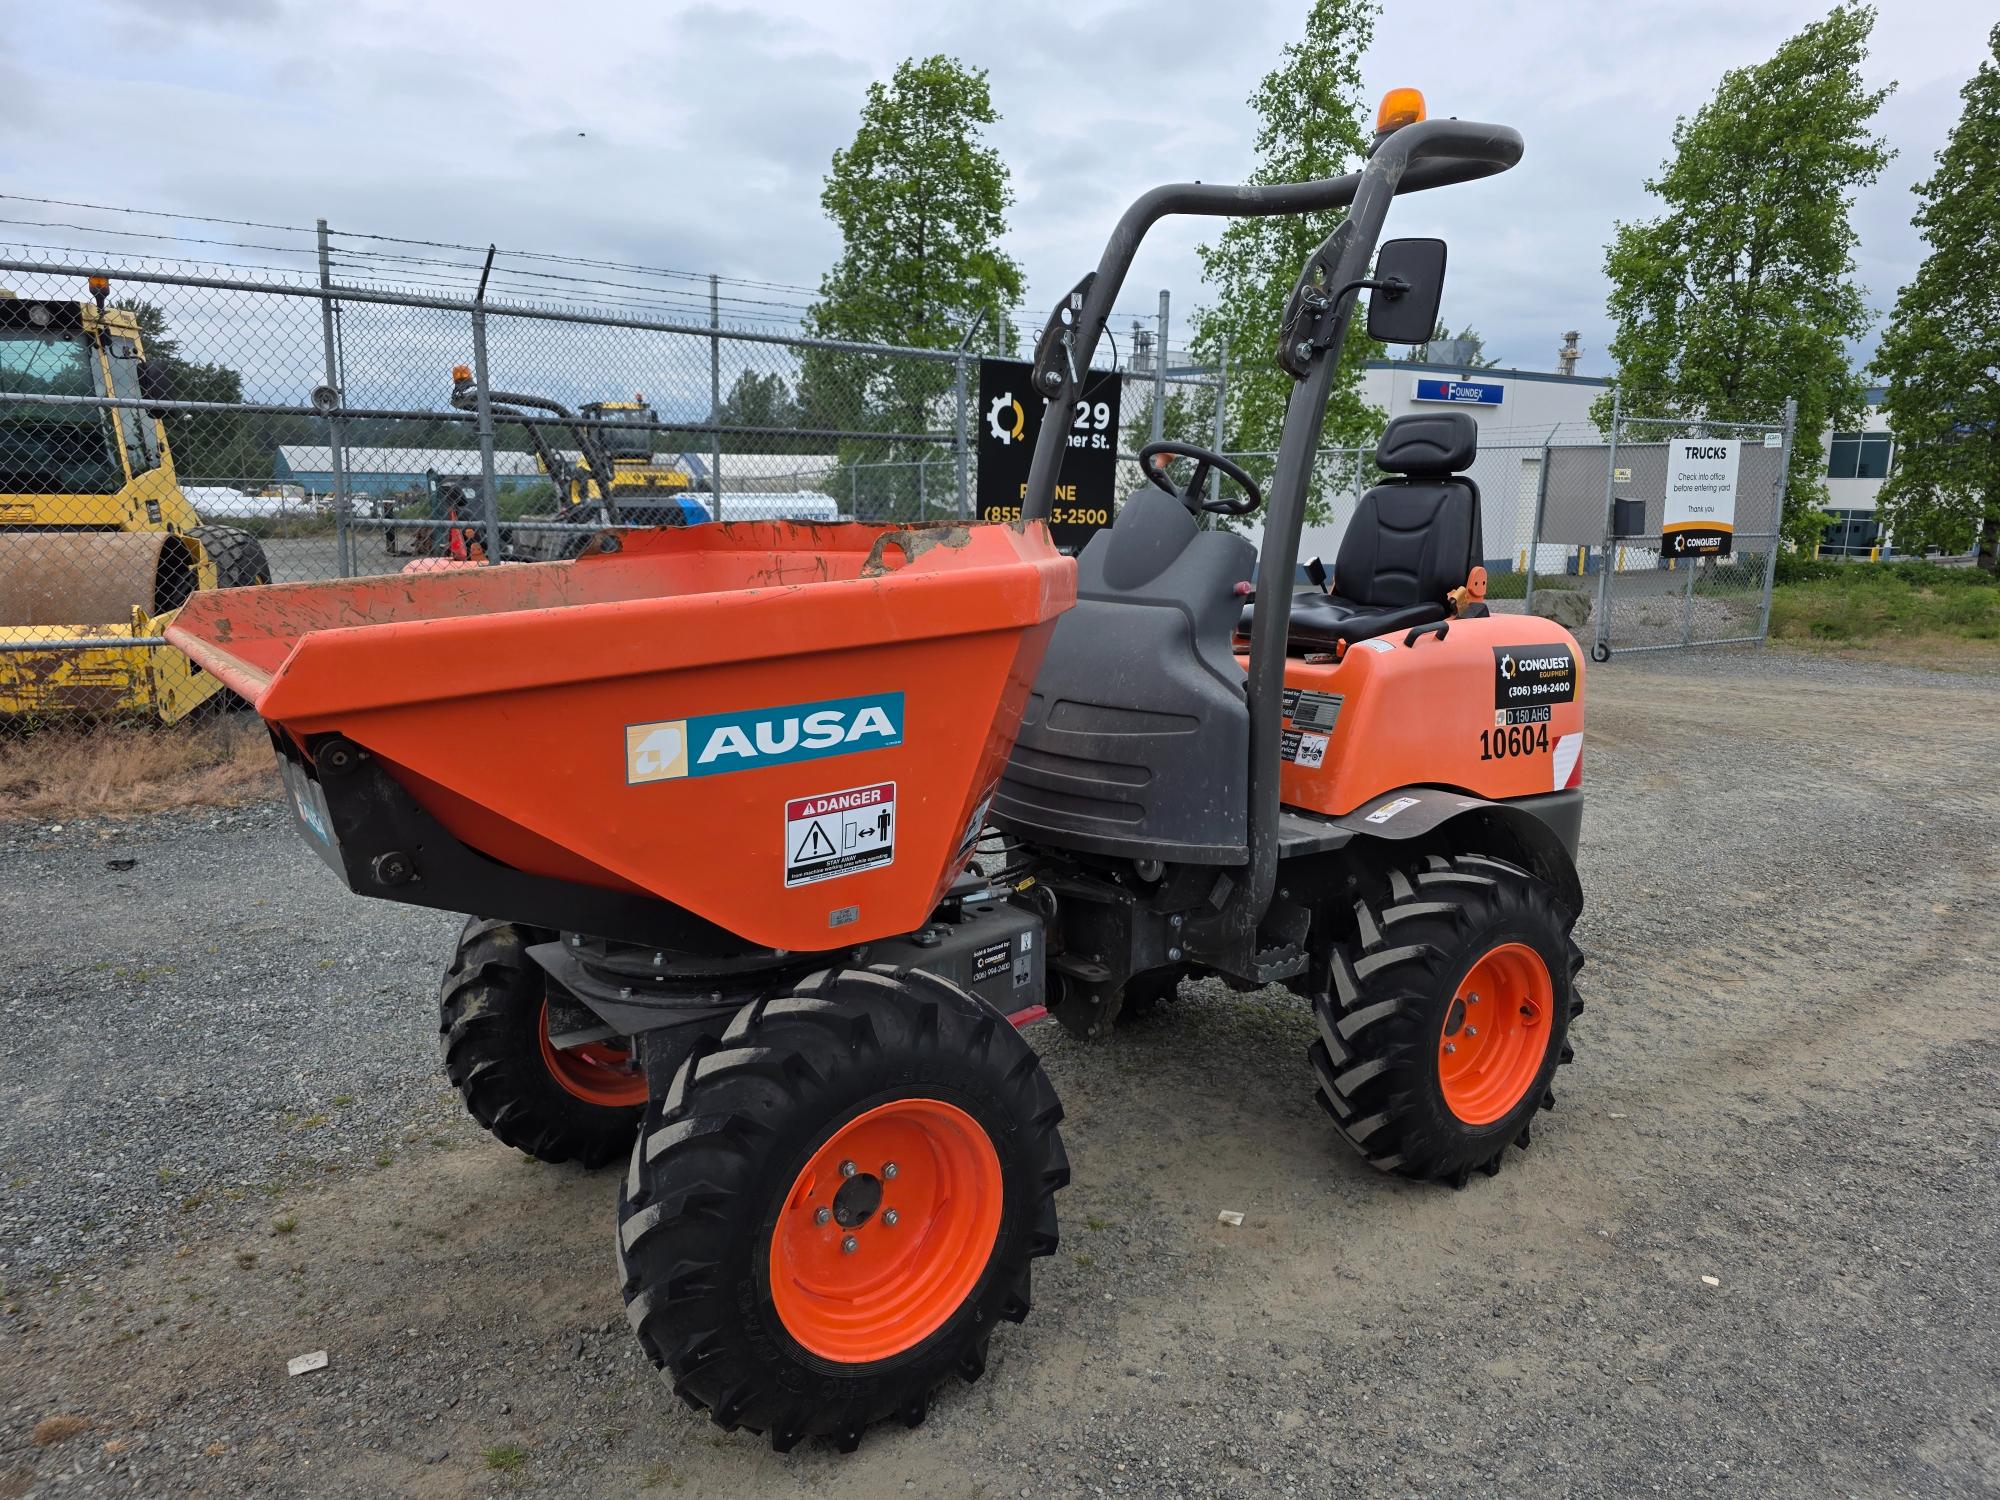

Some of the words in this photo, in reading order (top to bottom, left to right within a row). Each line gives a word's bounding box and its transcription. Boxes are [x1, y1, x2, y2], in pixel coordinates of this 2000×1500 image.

[1091, 433, 1110, 449] St.
[1685, 446, 1727, 460] TRUCKS
[1678, 472, 1697, 481] Check
[1698, 472, 1709, 481] into
[1710, 472, 1726, 481] office
[1020, 483, 1077, 500] PNE
[1673, 484, 1693, 492] before
[1694, 484, 1718, 494] entering
[1718, 484, 1731, 494] yard
[984, 506, 1021, 522] (855
[1048, 508, 1108, 525] 3-2500
[1688, 505, 1703, 513] Thank
[1704, 505, 1715, 514] you
[1686, 538, 1721, 547] CONQUEST
[1519, 657, 1569, 672] CONQUEST
[1540, 670, 1569, 678] EQUIPMENT
[1508, 686, 1530, 697] (306)
[1532, 682, 1570, 695] 994-2400
[1507, 711, 1513, 724] D
[1516, 709, 1530, 723] 150
[1531, 707, 1549, 721] AHG
[697, 706, 897, 764] AUSA
[1480, 723, 1549, 760] 10604
[817, 789, 881, 813] DANGER
[803, 868, 824, 876] machine
[824, 864, 843, 873] working
[855, 857, 867, 865] while
[826, 858, 841, 867] STAY
[841, 854, 857, 864] AWAY
[985, 952, 1006, 964] CONQUEST
